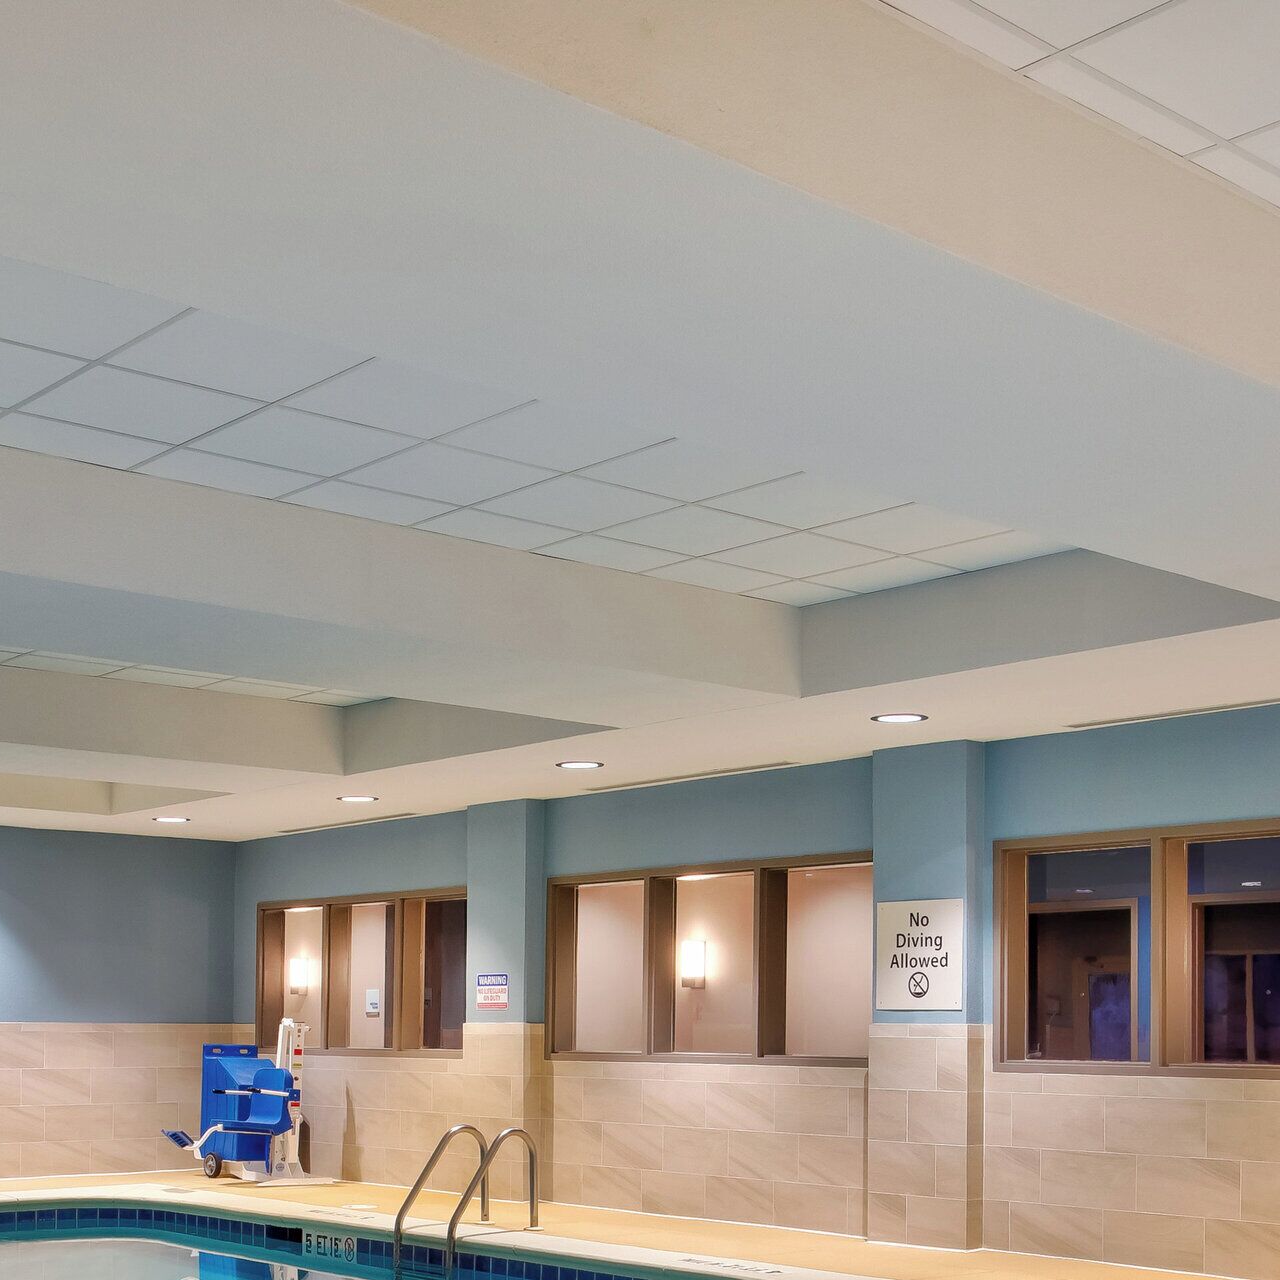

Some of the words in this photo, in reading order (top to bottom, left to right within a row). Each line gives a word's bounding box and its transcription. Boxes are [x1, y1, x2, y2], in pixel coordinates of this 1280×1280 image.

[909, 912, 929, 927] No
[896, 932, 943, 951] Diving
[890, 952, 949, 969] Allowed
[478, 976, 506, 985] WARNING
